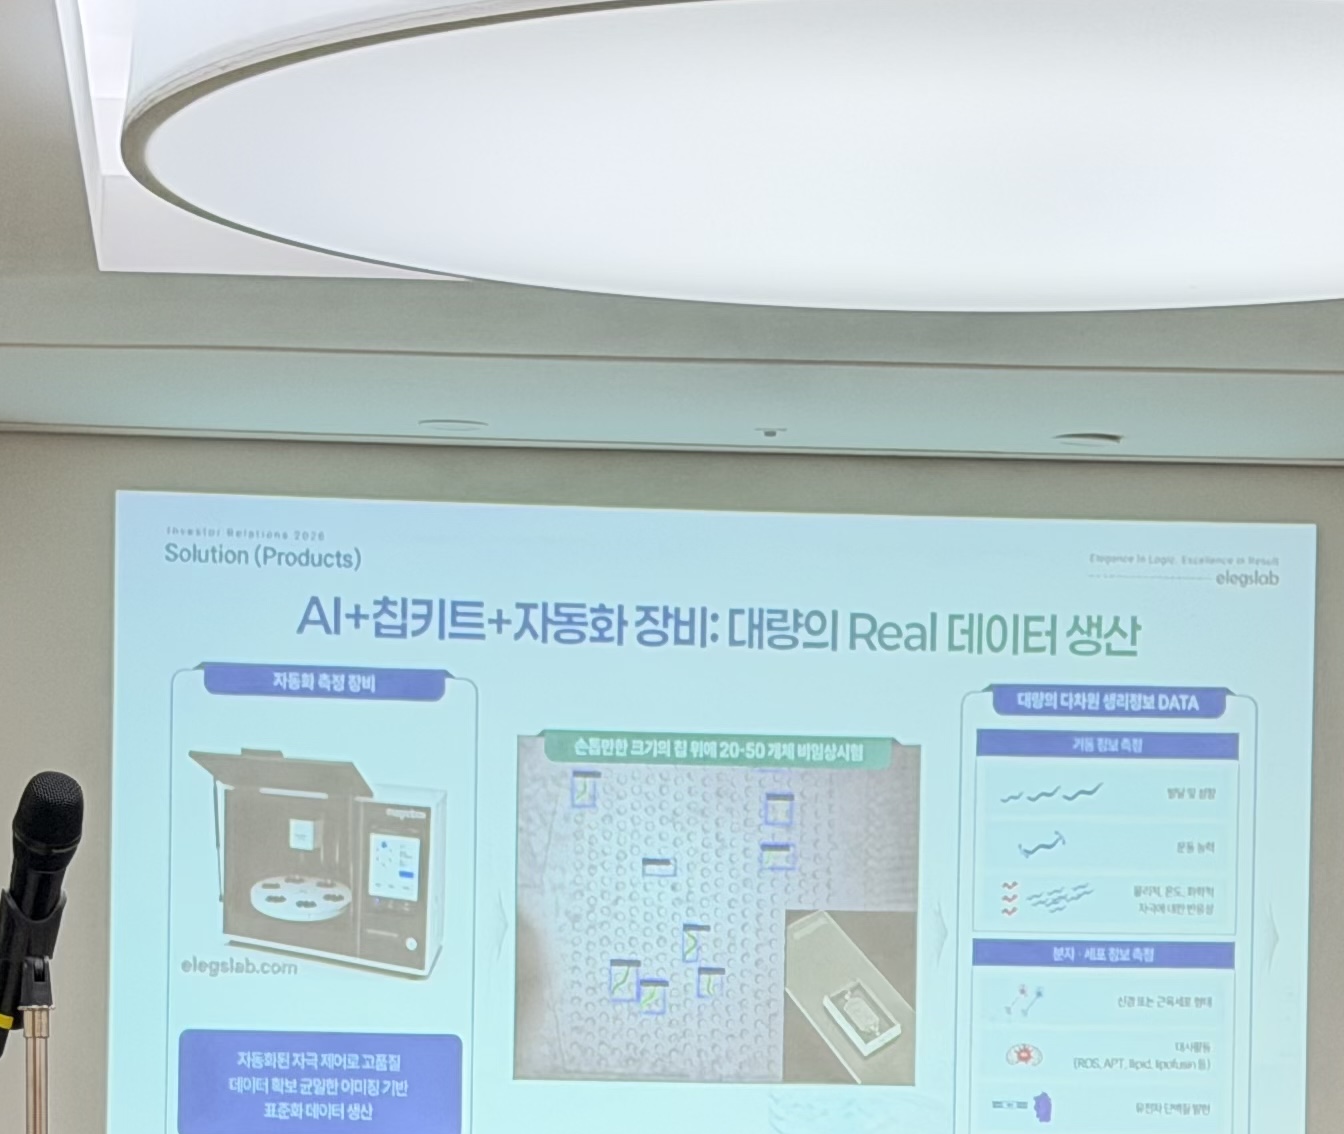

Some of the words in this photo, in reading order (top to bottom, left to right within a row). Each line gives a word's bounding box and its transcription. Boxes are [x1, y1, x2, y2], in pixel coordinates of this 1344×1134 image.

[166, 526, 221, 538] Investor
[227, 528, 288, 540] Relations
[294, 530, 325, 542] 2026
[164, 543, 249, 565] Solution
[255, 544, 362, 572] (Products)
[1216, 569, 1280, 588] elegslab
[297, 595, 628, 646] AI+칩키트+자동화
[635, 604, 720, 649] 장비:
[728, 607, 838, 651] 대량의
[849, 612, 938, 653] Real
[947, 613, 1057, 656] 데이터
[1066, 615, 1141, 658] 생산
[273, 672, 314, 691] 자동화
[318, 673, 345, 692] 측정
[348, 674, 376, 693] 장비
[1017, 692, 1057, 710] 대량의
[1060, 692, 1100, 710] 다차원
[1158, 695, 1200, 711] DATA
[631, 739, 671, 758] 크기의
[719, 741, 765, 759] 20-50
[181, 956, 298, 977] elegslab.com
[237, 1051, 290, 1070] 자동화된
[292, 1052, 318, 1070] 자극
[321, 1053, 360, 1071] 제어로
[362, 1054, 400, 1072] 고품질
[229, 1077, 268, 1094] 데이터
[341, 1079, 379, 1097] 이미징
[382, 1079, 408, 1097] 기반
[306, 1103, 344, 1120] 데이터
